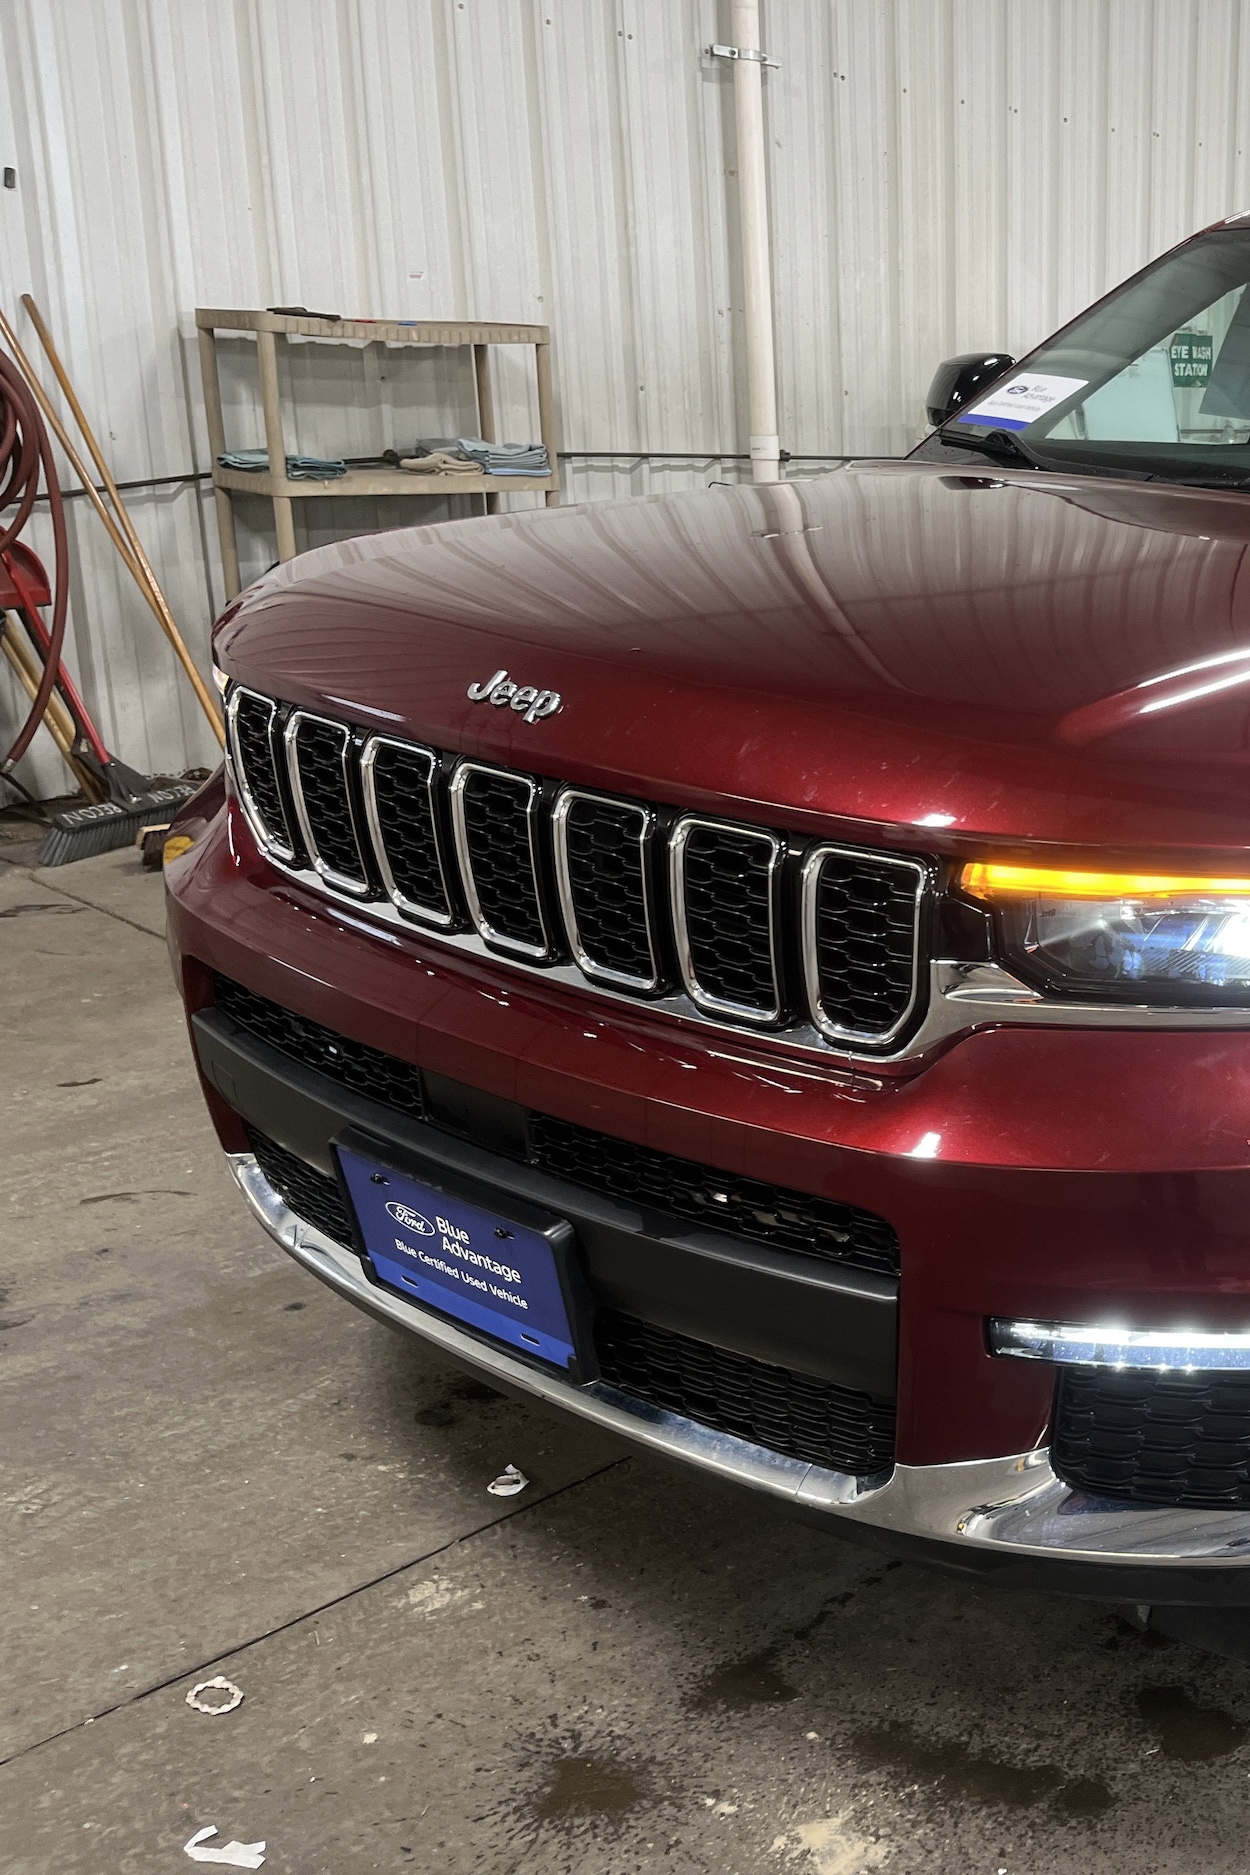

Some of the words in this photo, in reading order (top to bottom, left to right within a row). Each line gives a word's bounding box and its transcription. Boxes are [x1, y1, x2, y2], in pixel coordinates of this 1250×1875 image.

[1171, 345, 1190, 359] EYE
[467, 669, 561, 723] Jeep
[435, 1215, 471, 1245] Blue
[394, 1238, 418, 1259] Blue
[418, 1250, 460, 1280] Certified
[460, 1270, 488, 1292] Used
[489, 1283, 529, 1310] Vehicle
[442, 1236, 522, 1284] Advantage
